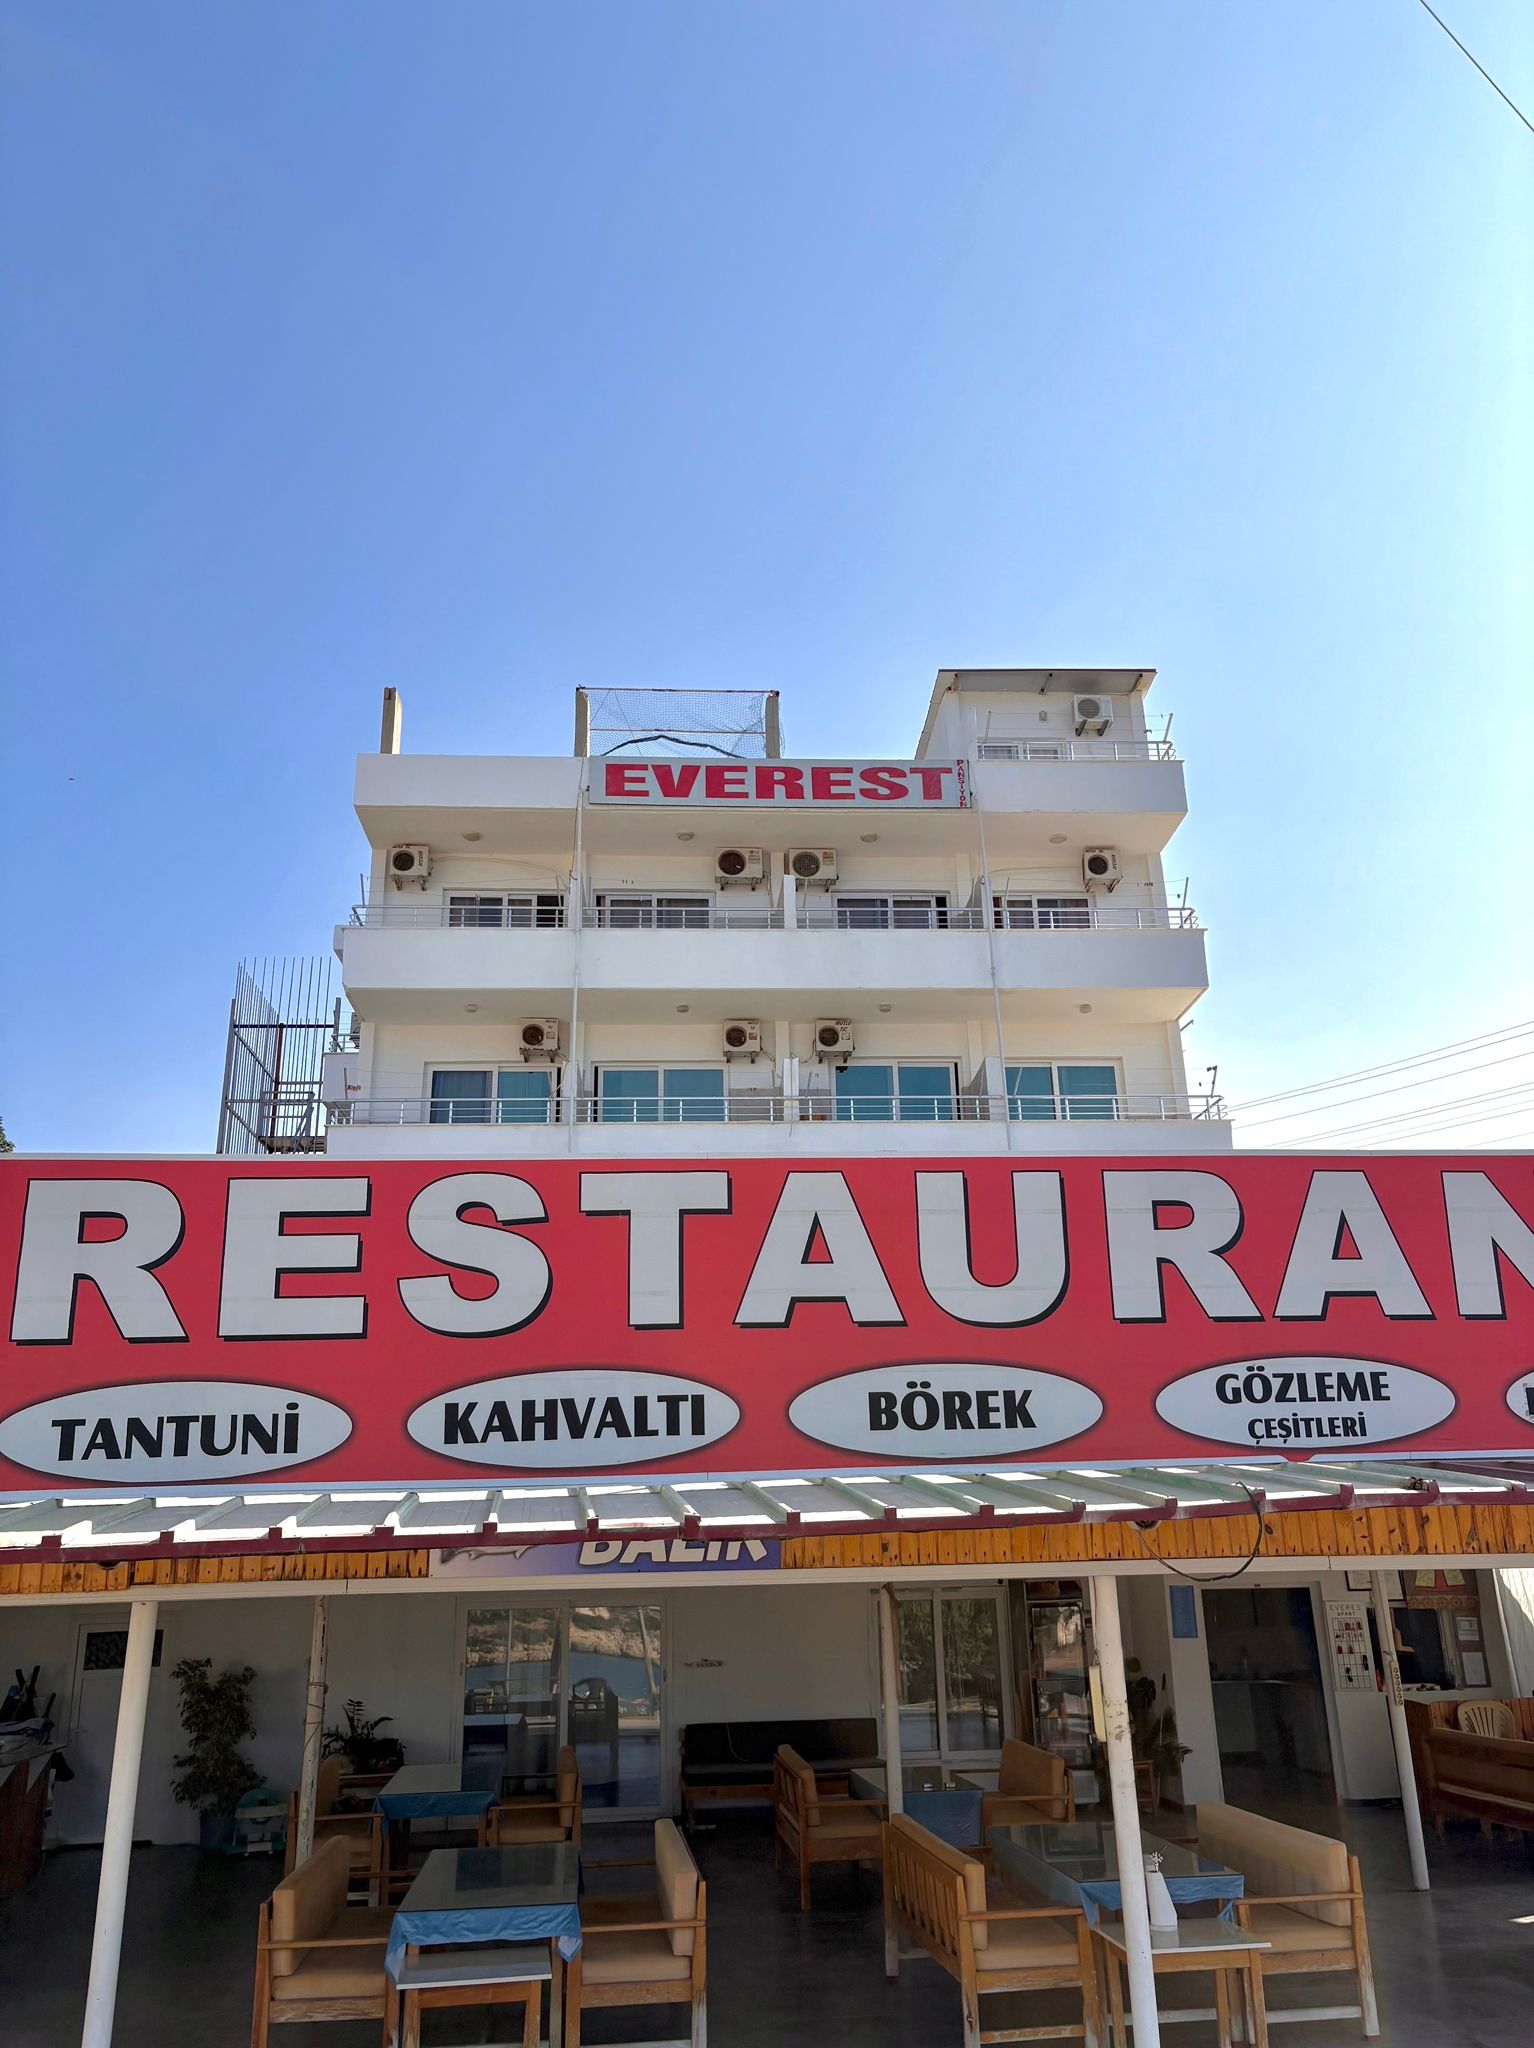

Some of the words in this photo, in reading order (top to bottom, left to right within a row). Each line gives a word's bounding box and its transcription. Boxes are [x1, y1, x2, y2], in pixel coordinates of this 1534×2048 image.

[605, 763, 953, 801] EVEREST
[868, 1381, 1037, 1431] BÖREK
[1215, 1365, 1391, 1404] GÖZLEME
[51, 1402, 300, 1461] TANTUNİ
[443, 1394, 706, 1445] KAHVALTI
[1247, 1411, 1368, 1444] ÇEŞİTLERİ
